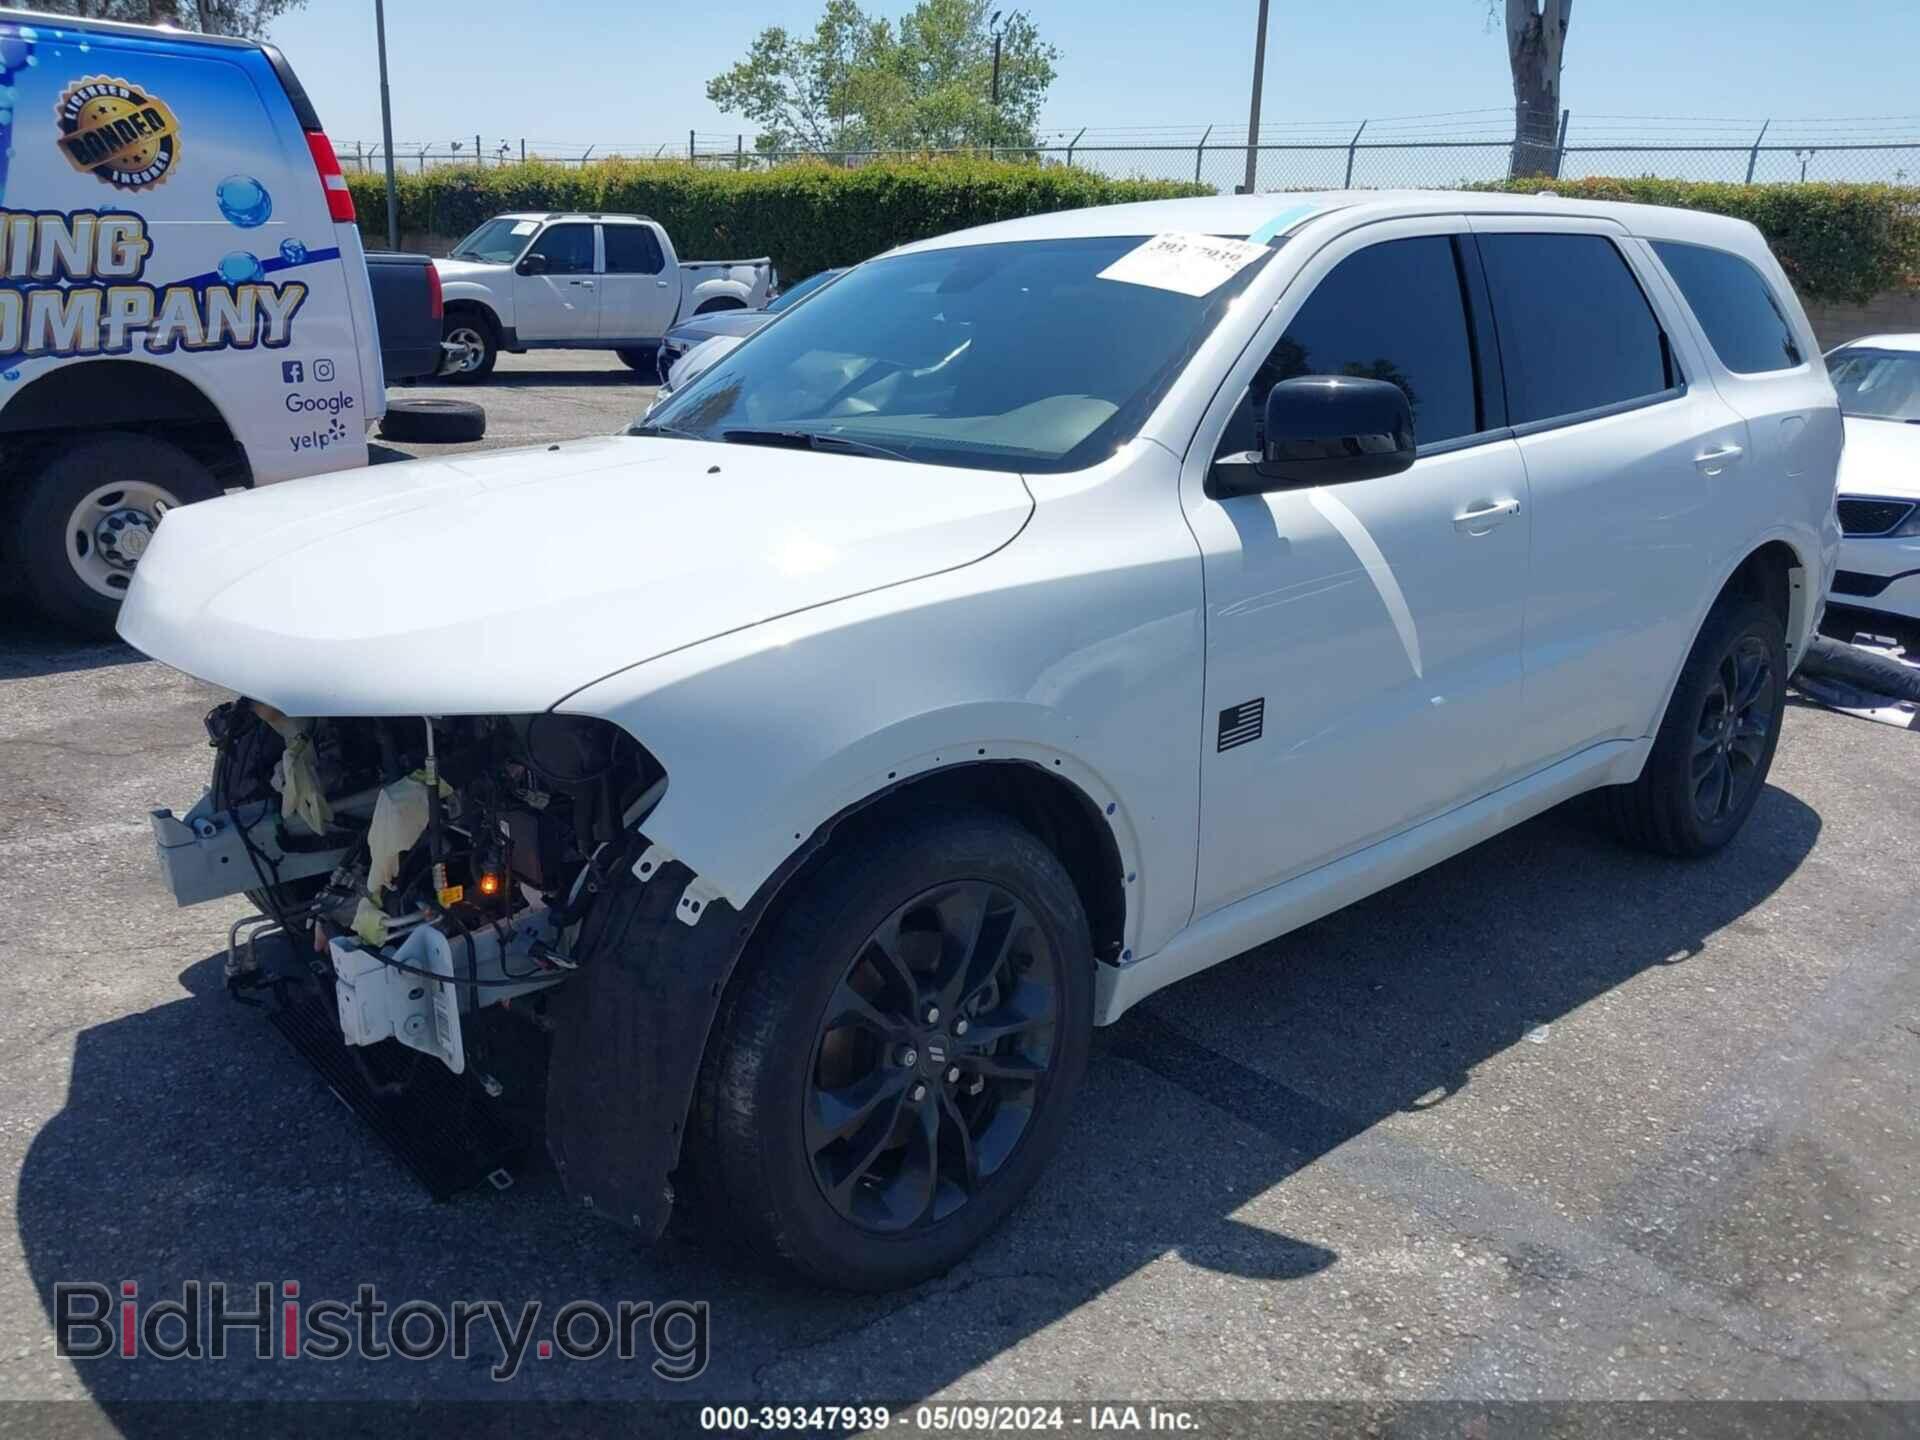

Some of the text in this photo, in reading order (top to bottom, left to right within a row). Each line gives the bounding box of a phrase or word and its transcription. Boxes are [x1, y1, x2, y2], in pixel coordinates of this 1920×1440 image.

[64, 84, 130, 120] LICENSED
[66, 107, 166, 166] BONDED
[112, 151, 170, 185] INSURED
[0, 208, 152, 284] ING
[285, 390, 355, 416] Google
[289, 431, 331, 453] yelp
